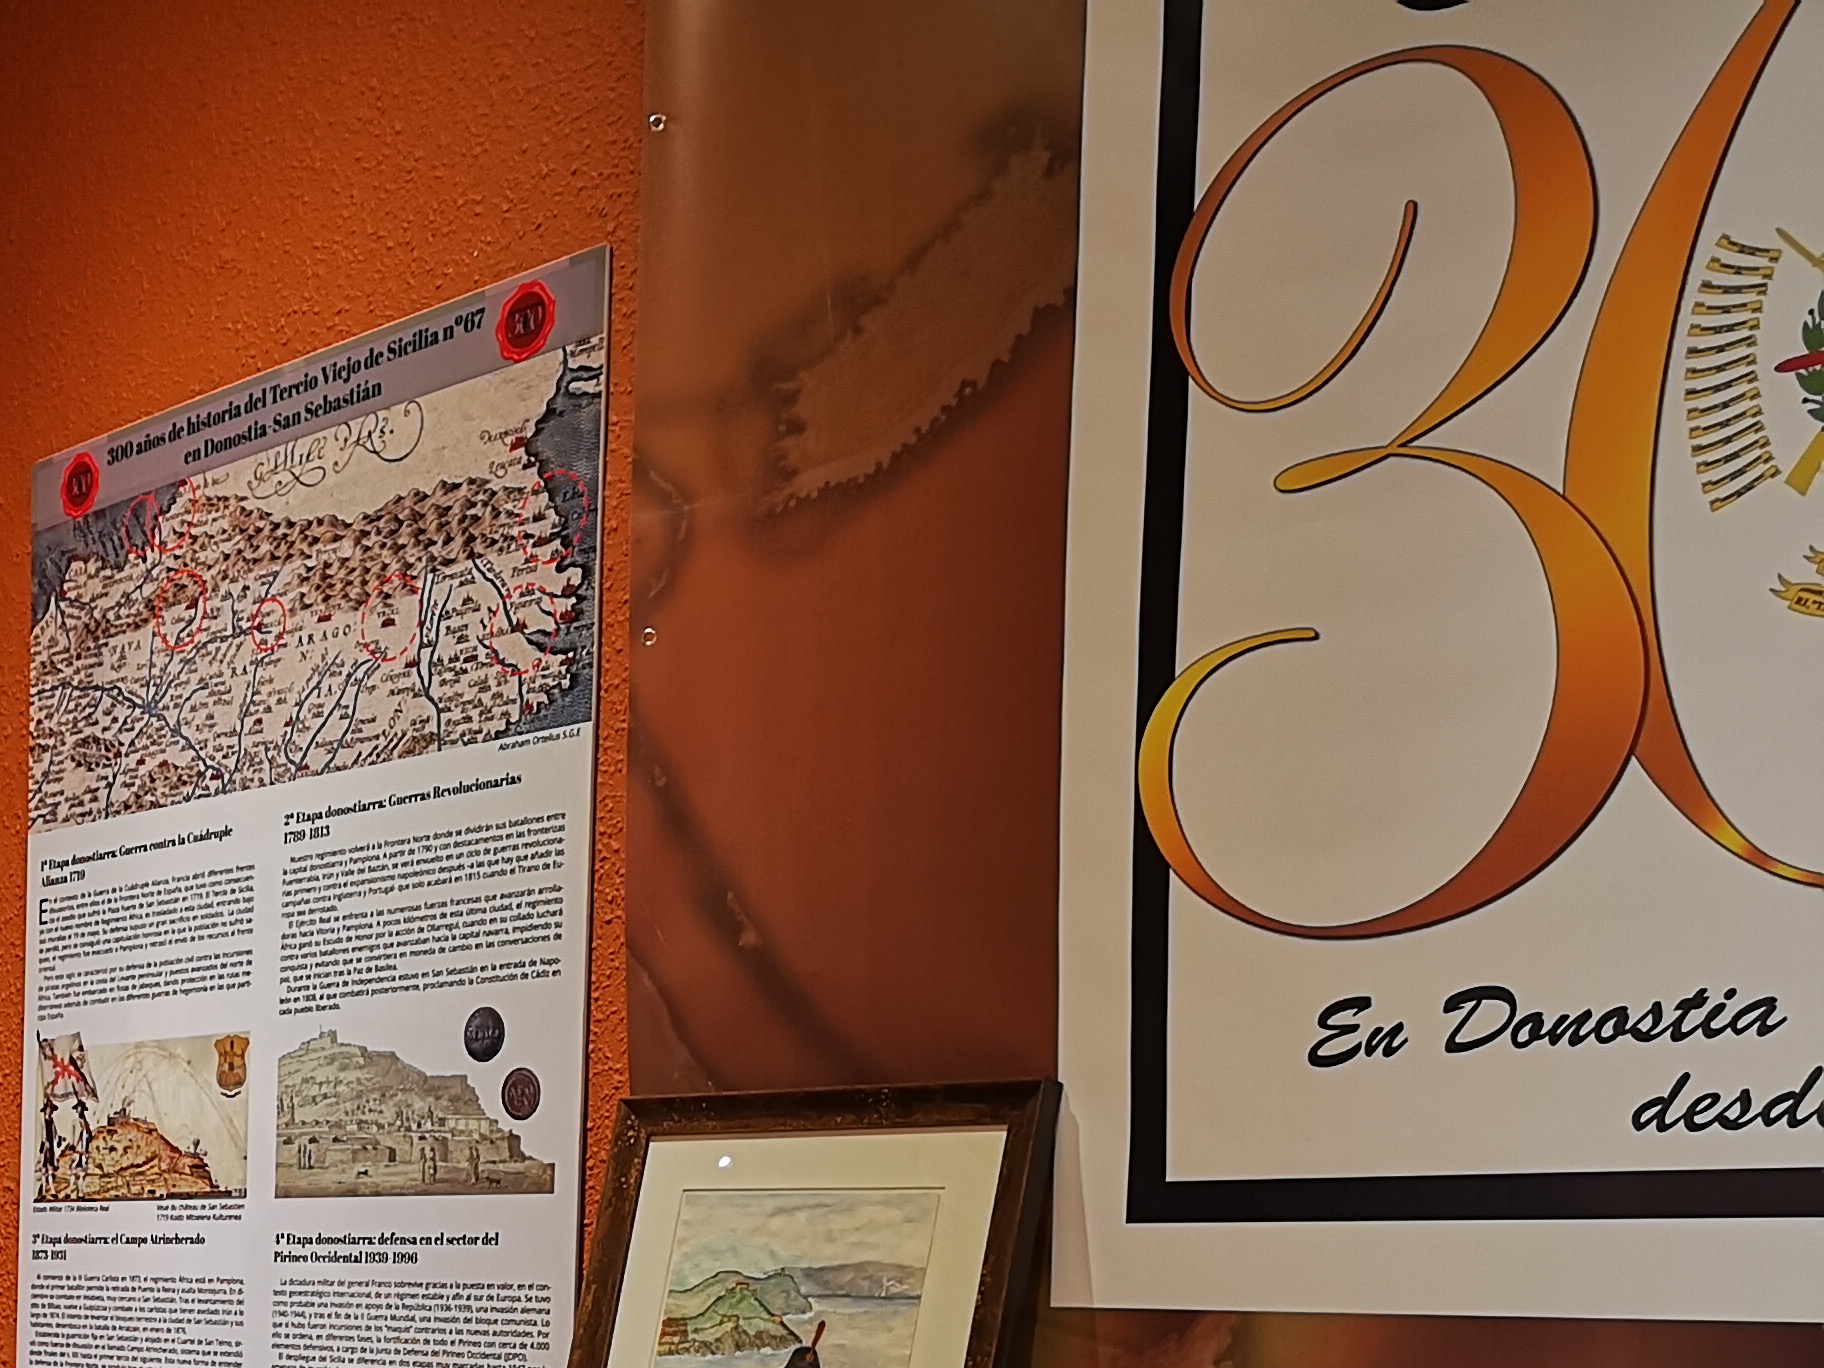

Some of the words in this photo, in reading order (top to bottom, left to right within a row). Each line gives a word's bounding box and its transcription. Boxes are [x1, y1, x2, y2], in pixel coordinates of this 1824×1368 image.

[107, 440, 134, 465] 300
[135, 433, 166, 455] años
[168, 422, 185, 442] de
[186, 401, 242, 435] historia
[244, 388, 267, 414] del
[269, 373, 319, 404] Tercio
[321, 356, 362, 384] Viejo
[363, 347, 384, 369] de
[387, 328, 440, 361] Sicilia
[184, 447, 201, 464] en
[304, 380, 382, 421] Sebastián
[296, 811, 324, 824] Etapa
[388, 791, 431, 806] Guerras
[433, 773, 522, 798] Revolucionarias
[1308, 997, 1409, 1067] En
[1443, 986, 1788, 1054] Donostia
[274, 1250, 309, 1262] Pirineo
[310, 1250, 363, 1263] Occidental
[286, 1233, 314, 1248] Etapa
[378, 1232, 418, 1245] defensa
[419, 1236, 433, 1245] en
[434, 1231, 445, 1245] el
[446, 1234, 480, 1245] sector
[481, 1231, 499, 1245] del
